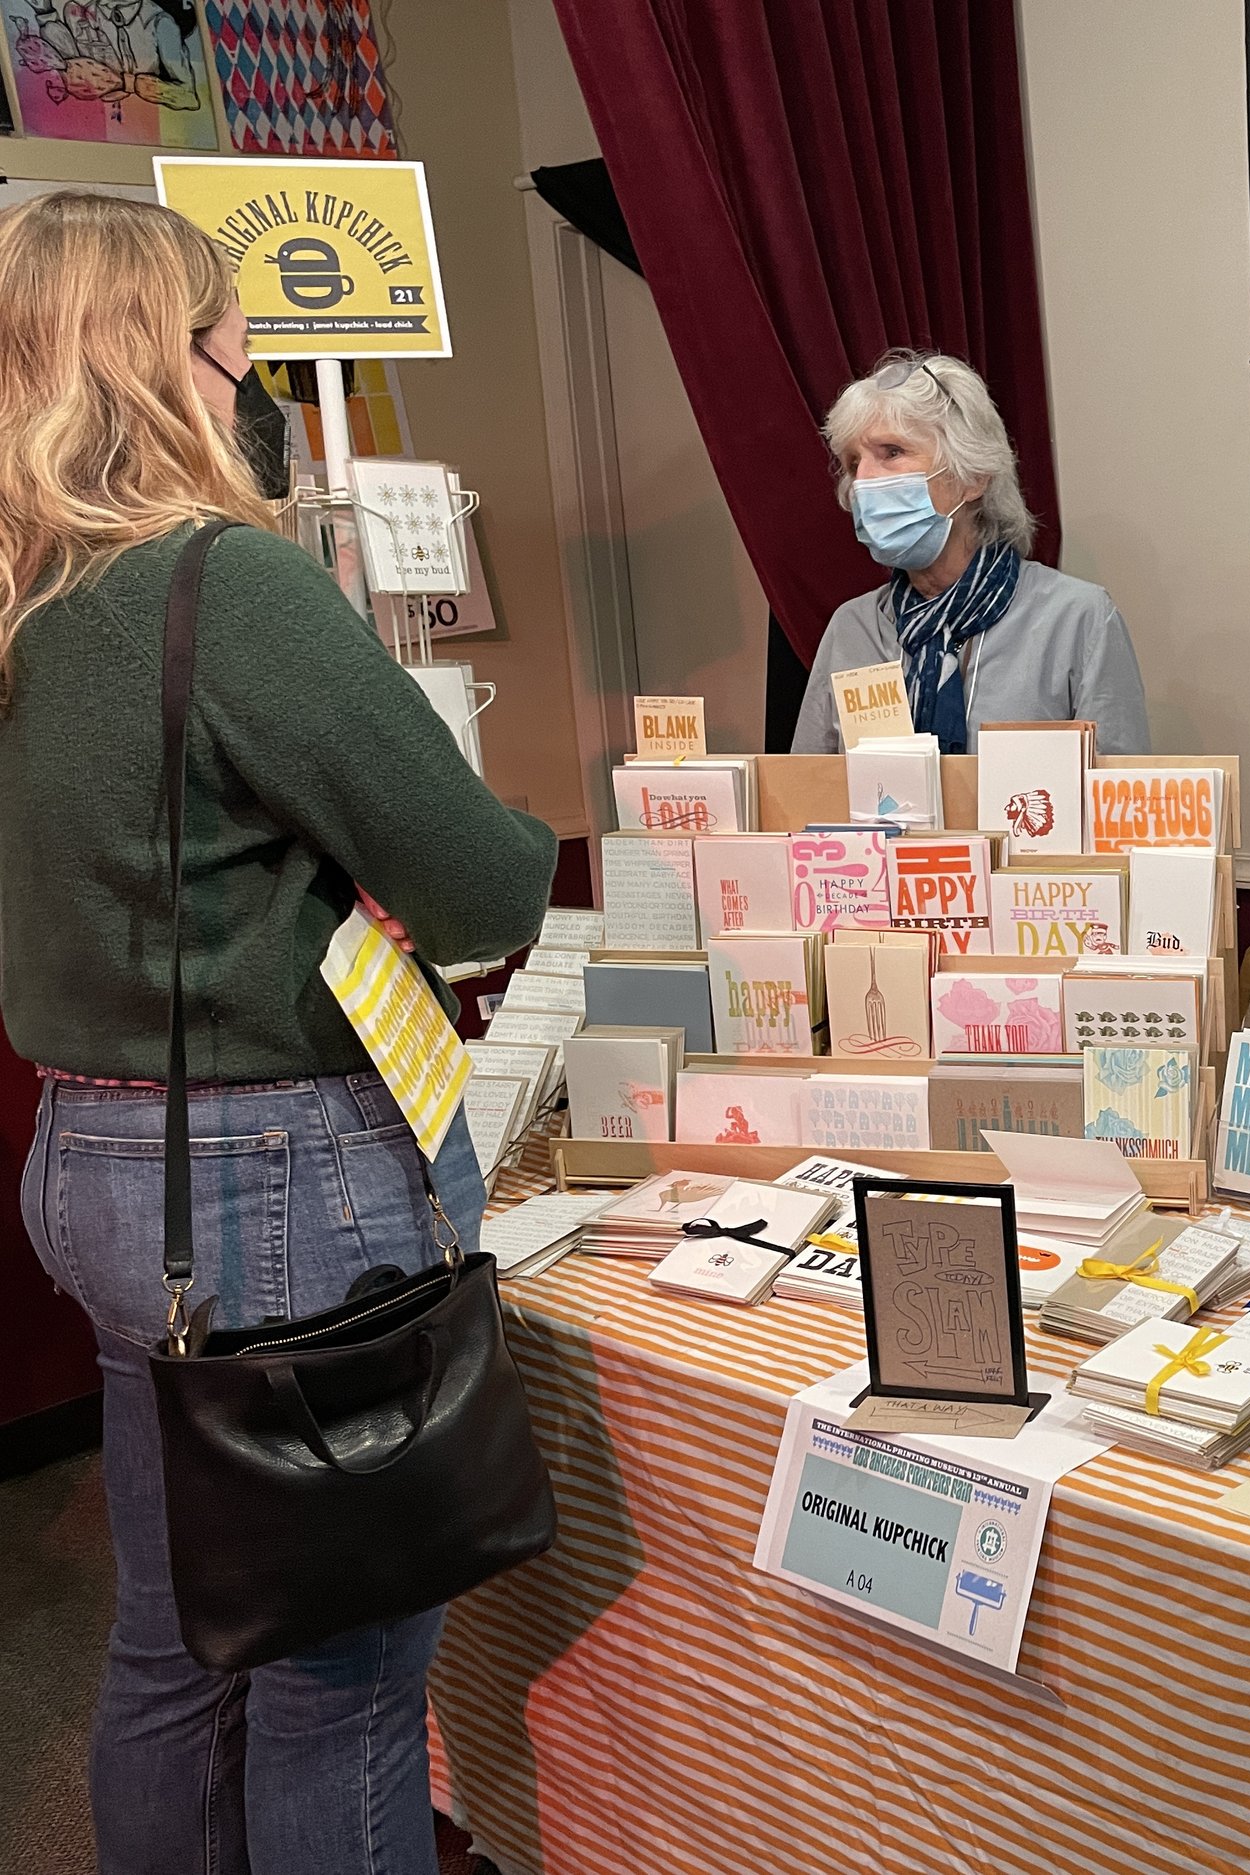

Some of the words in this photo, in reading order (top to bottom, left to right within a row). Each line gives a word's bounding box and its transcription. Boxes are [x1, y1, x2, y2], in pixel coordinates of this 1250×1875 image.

[216, 191, 298, 273] RIGINAL
[305, 190, 413, 274] KUPCHICK
[394, 289, 414, 303] 21
[415, 566, 429, 577] my
[843, 680, 902, 713] BLANK
[853, 706, 900, 724] INSIDE
[643, 715, 698, 739] BLANK
[650, 741, 694, 751] INSIDE
[720, 880, 738, 894] WHAT
[819, 879, 864, 889] HAPPY
[722, 896, 748, 911] COMES
[1013, 882, 1092, 907] HAPPY
[816, 904, 870, 914] BIRTHDAY
[1010, 909, 1099, 920] BIRTH
[723, 912, 744, 927] AFTER
[891, 916, 989, 929] BIRTH
[1016, 922, 1093, 955] DAY
[964, 1024, 1001, 1052] THANK
[600, 1115, 633, 1138] BEER
[796, 1249, 862, 1281] DA
[893, 1281, 1002, 1363] SLAM
[816, 1421, 831, 1433] THE
[831, 1425, 892, 1453] INTERNATIONAL
[892, 1445, 930, 1465] PRINTING
[931, 1458, 972, 1480] MUSEUM'S
[988, 1477, 1023, 1495] ANNUAL
[801, 1490, 868, 1534] ORIGINAL
[872, 1516, 949, 1563] KUPCHICK
